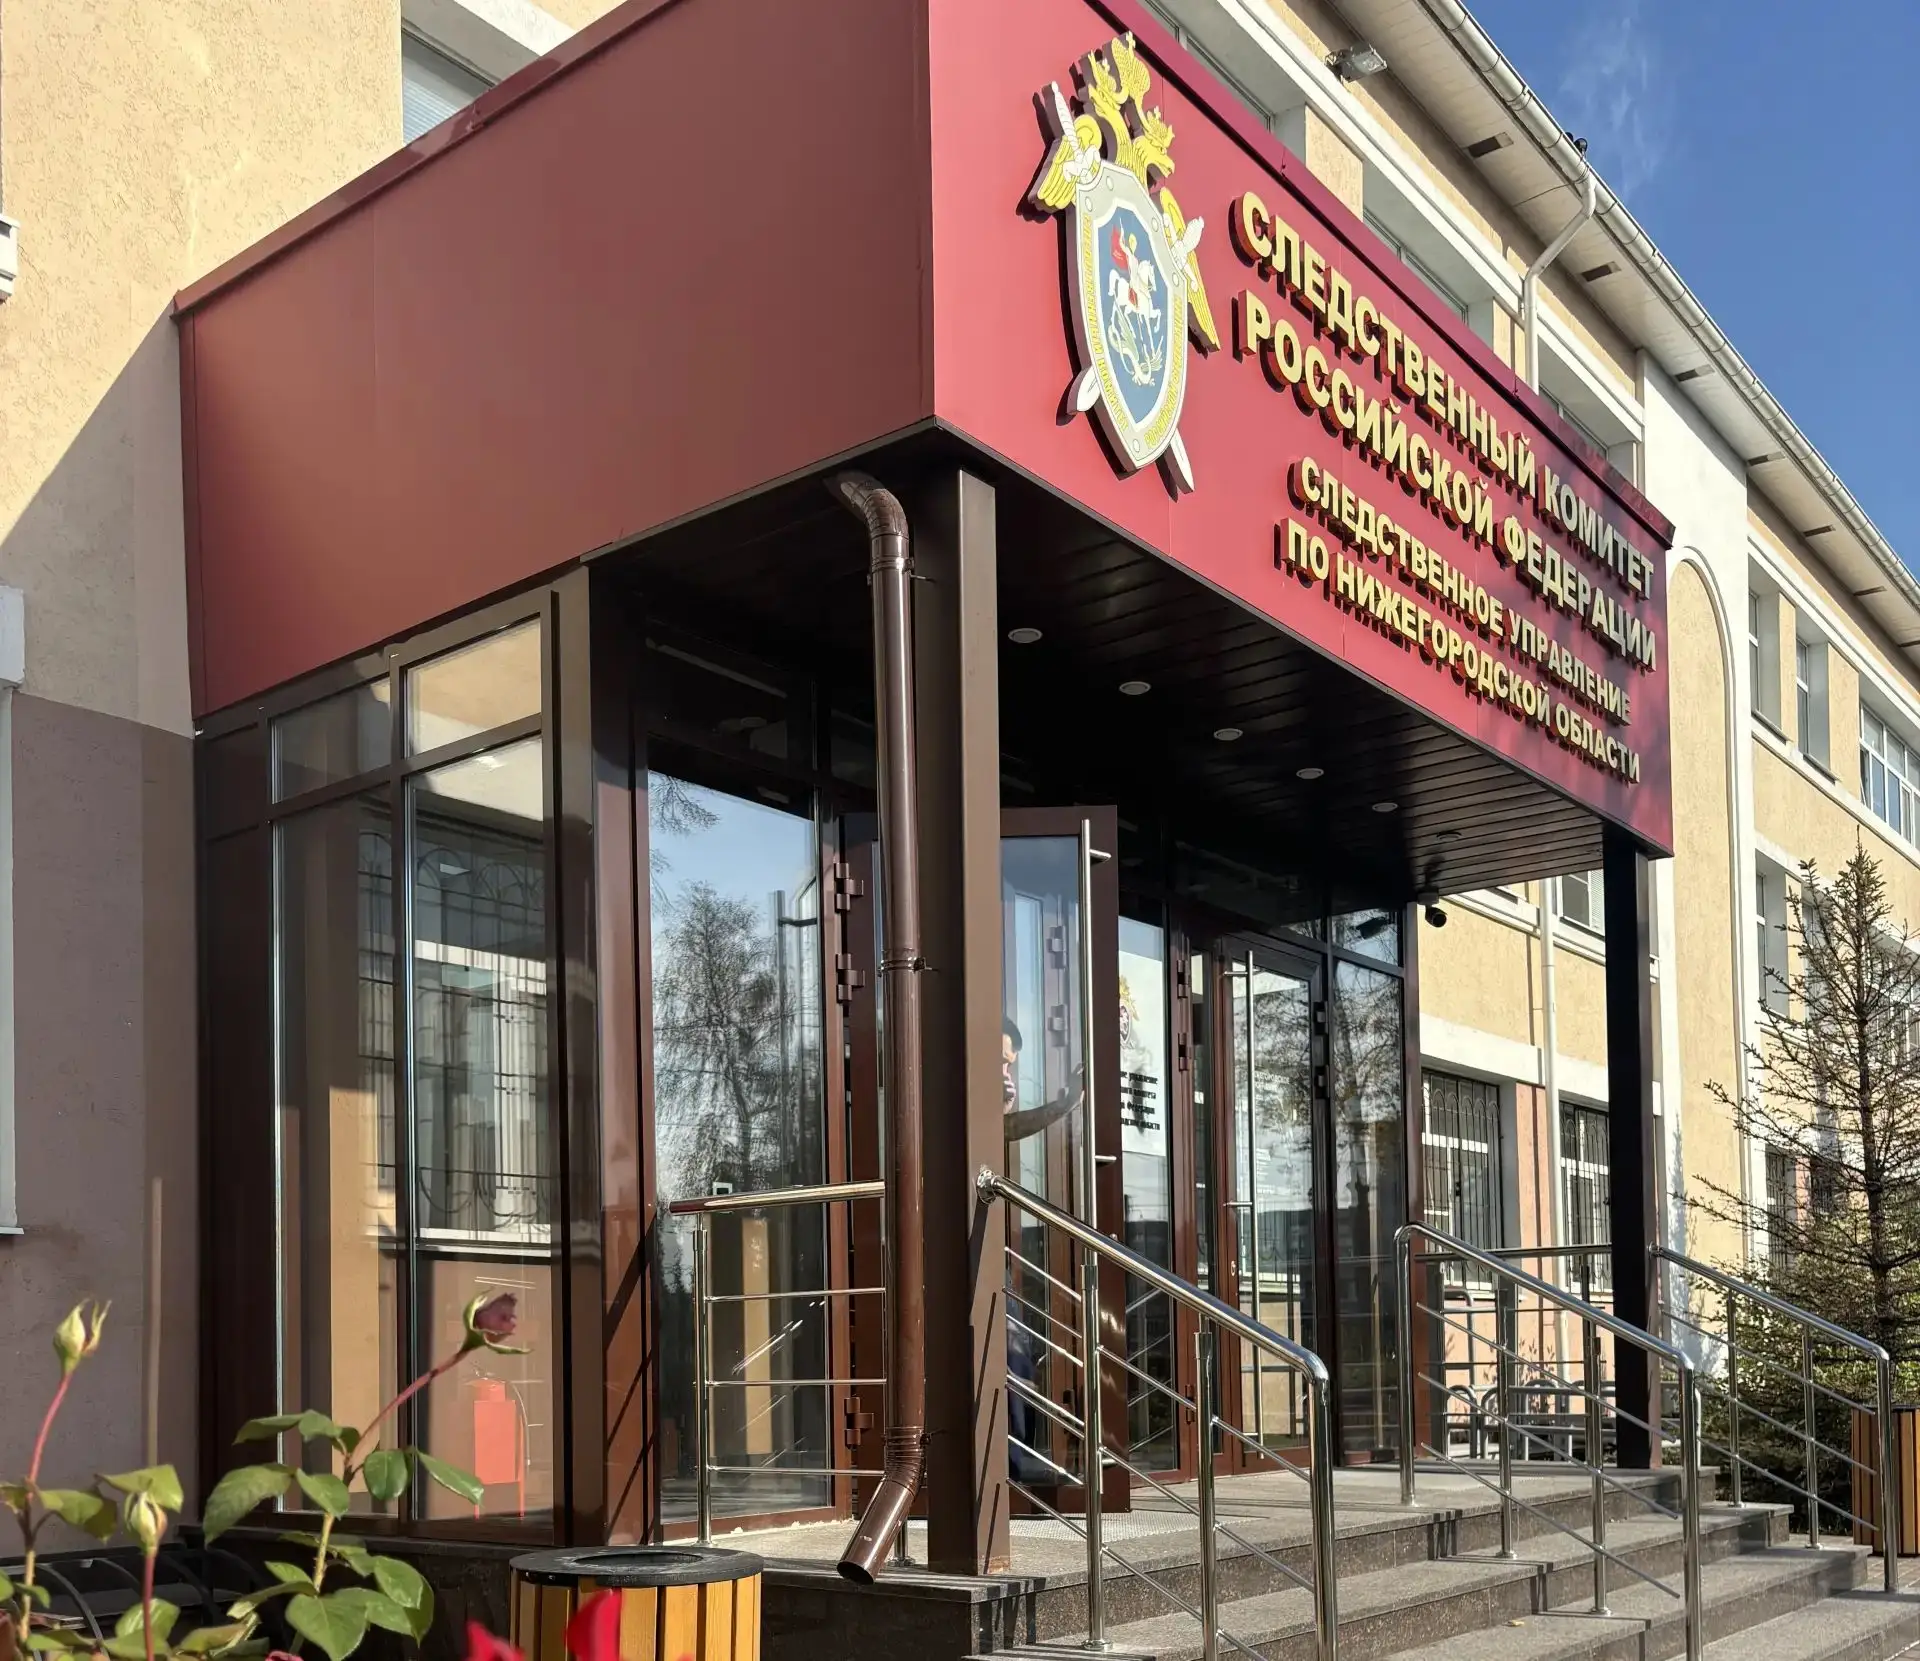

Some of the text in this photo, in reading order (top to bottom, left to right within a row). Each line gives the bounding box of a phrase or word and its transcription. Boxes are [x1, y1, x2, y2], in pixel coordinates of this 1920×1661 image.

[1242, 191, 1654, 600] СЛЕДСТВЕННЫЙ КОМИТЕТ
[1246, 289, 1656, 672] РОССИЙСКОЙ ФЕДЕРАЦИИ
[1288, 518, 1640, 784] ПО НИЖЕГОРОДСКОЙ ОБЛАСТИ
[1302, 456, 1631, 725] СЛЕДСТВЕННОЕ УПРАВЛЕНИЕ
